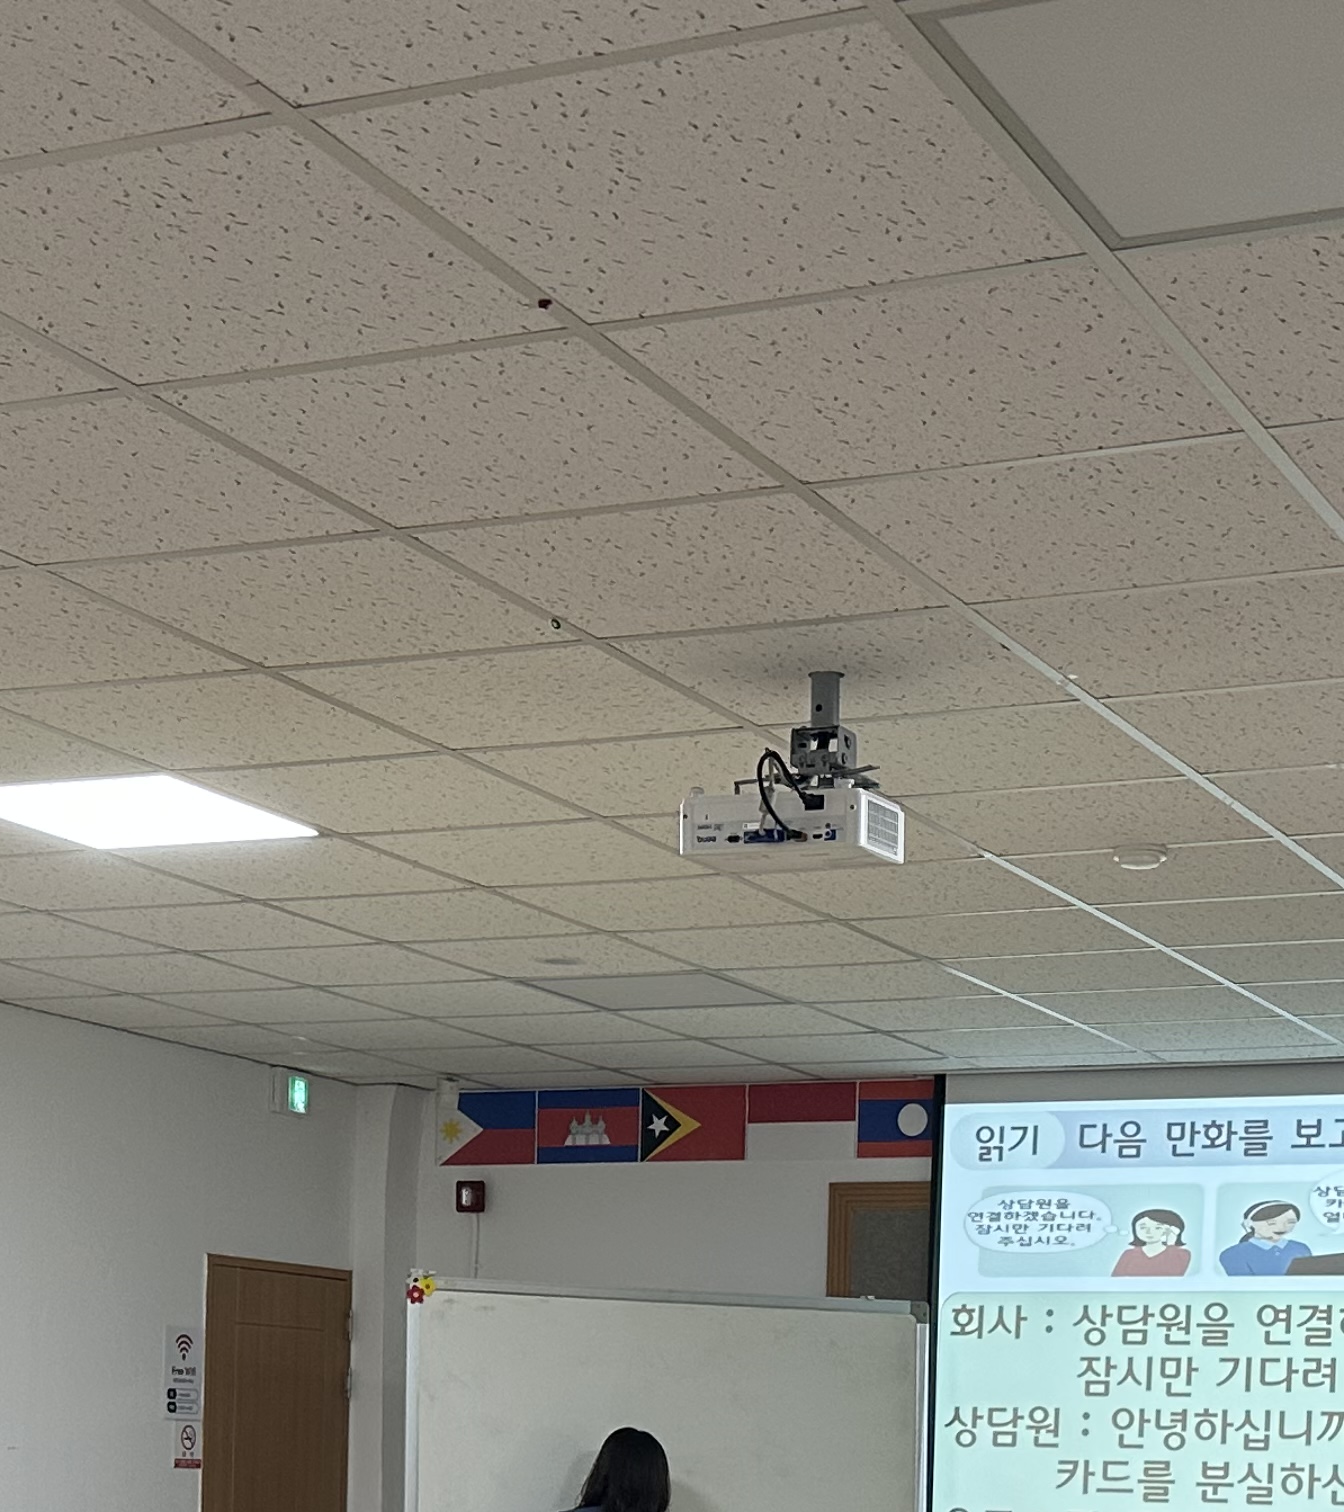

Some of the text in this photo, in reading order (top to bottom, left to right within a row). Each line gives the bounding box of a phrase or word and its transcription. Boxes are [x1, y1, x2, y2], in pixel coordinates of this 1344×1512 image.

[975, 1124, 1039, 1163] 읽기
[1078, 1120, 1148, 1159] 다음
[1166, 1118, 1274, 1158] 만화를
[967, 1210, 1102, 1223] 연결하겠습니다.
[997, 1198, 1071, 1211] 상담원을
[975, 1222, 1092, 1236] 잠시만 기다려
[997, 1235, 1075, 1248] 주십시오.
[949, 1303, 1029, 1340] 회사
[1071, 1301, 1236, 1347] 상담원을
[1076, 1355, 1200, 1398] 잠시만
[1215, 1356, 1337, 1394] 기다려
[943, 1405, 1061, 1449] 상담원
[1055, 1459, 1176, 1504] 카드를
